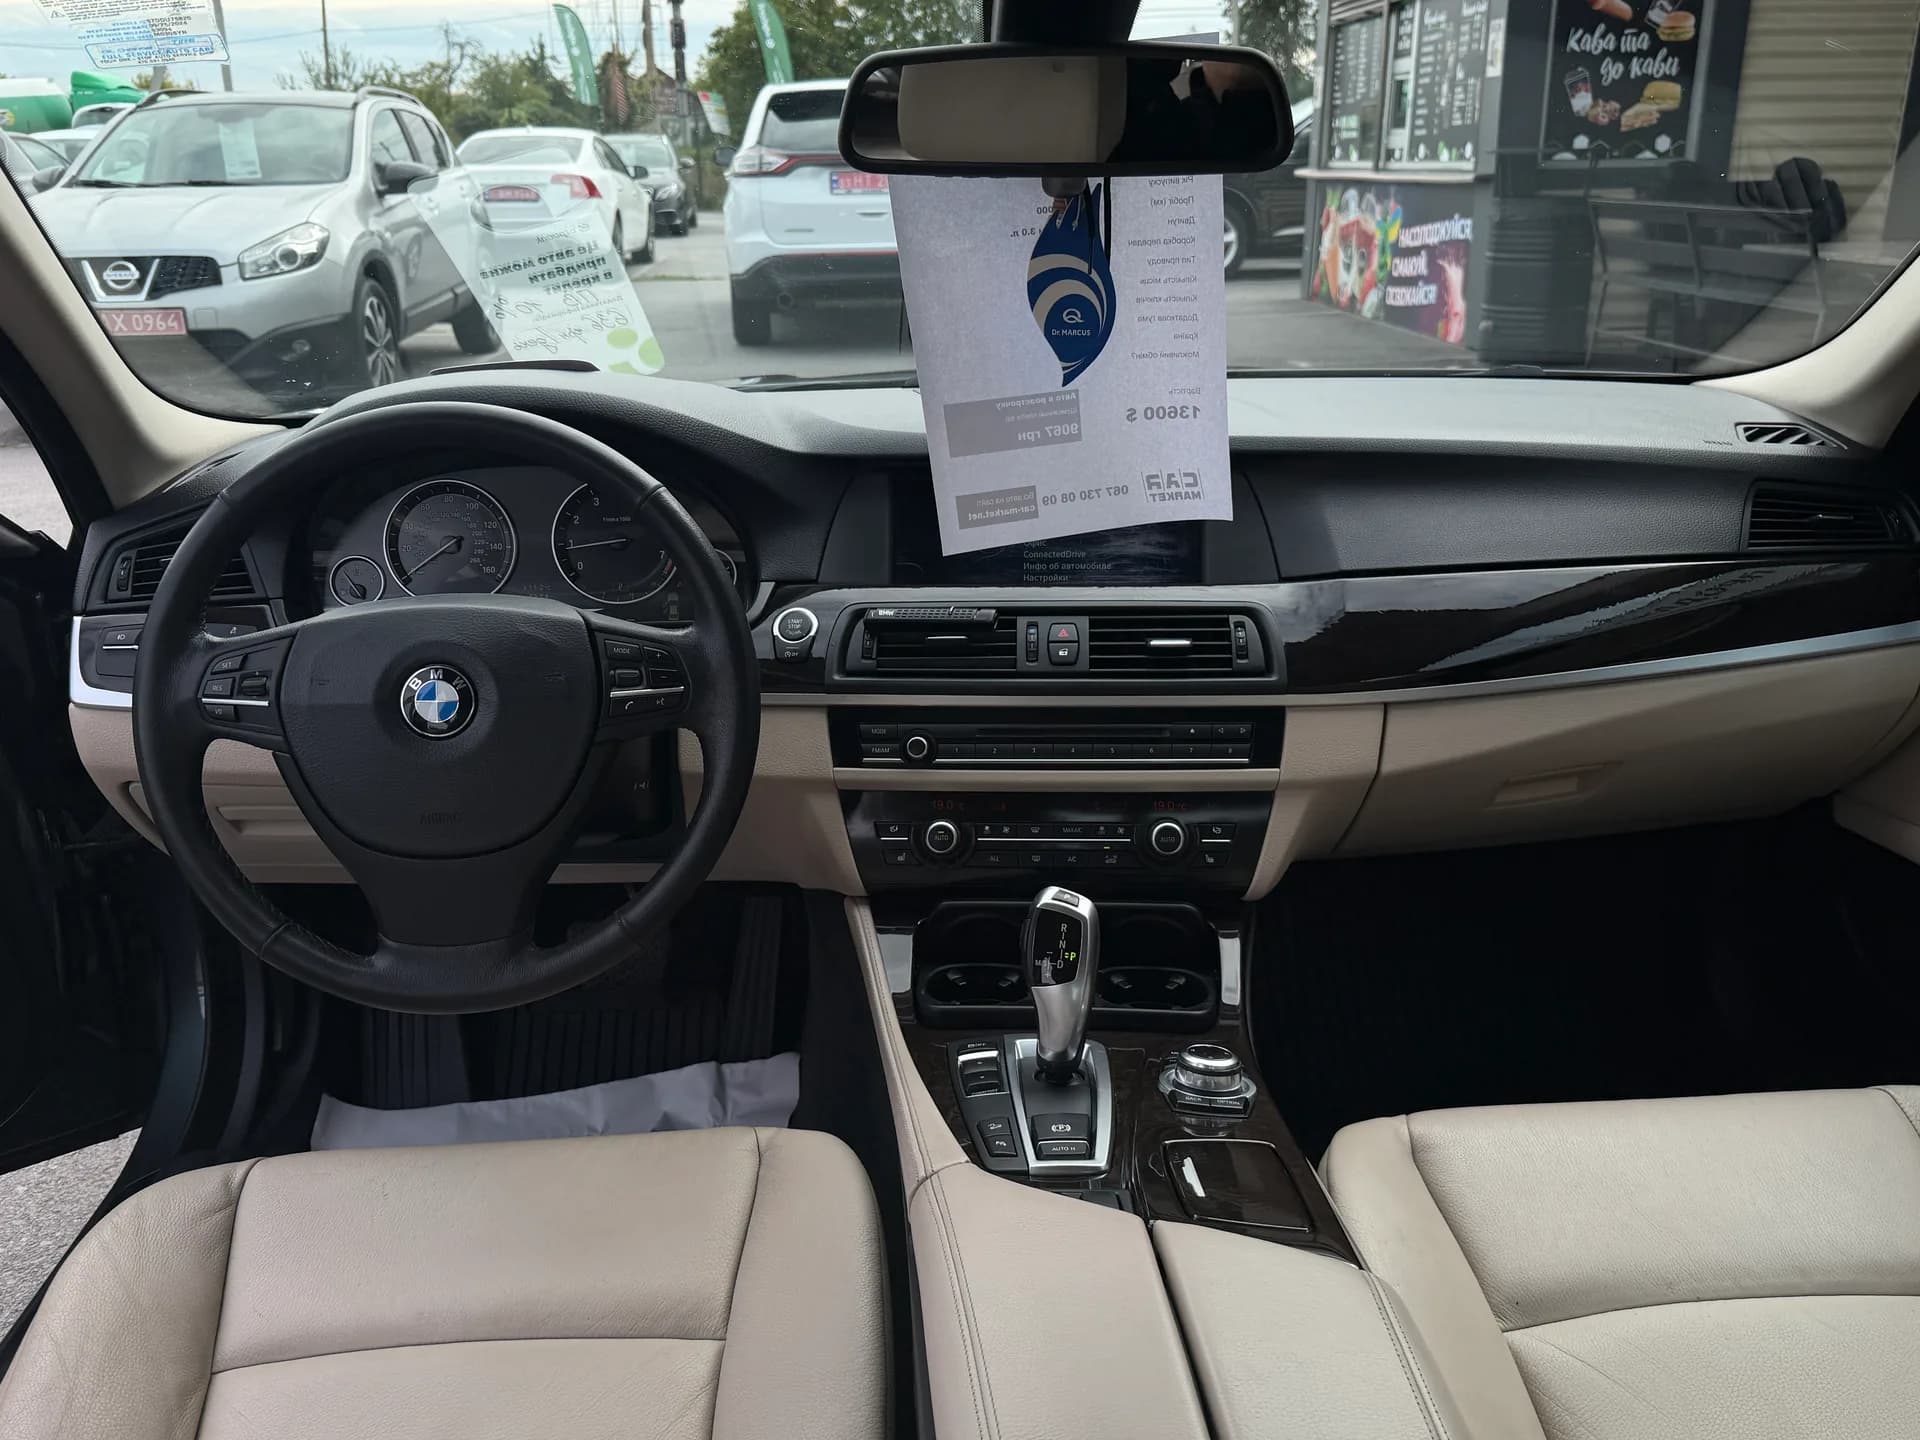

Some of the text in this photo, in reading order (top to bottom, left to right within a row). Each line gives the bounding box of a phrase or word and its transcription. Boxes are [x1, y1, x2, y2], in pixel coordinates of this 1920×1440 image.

[1567, 23, 1650, 55] Кава та
[1600, 48, 1680, 86] до кави
[132, 314, 178, 331] 0964
[1051, 328, 1091, 337] Dr. MARCUS
[593, 498, 600, 506] 3
[573, 516, 580, 524] 2
[659, 550, 665, 559] 7
[1023, 550, 1086, 559] ConnectedDrive
[577, 562, 583, 570] 0
[1023, 562, 1112, 572] Инфо об автомобиле
[1023, 573, 1069, 583] Настройки
[878, 609, 895, 617] BMW
[409, 669, 467, 691] BMW
[1061, 923, 1068, 932] R
[1059, 940, 1066, 949] N
[1070, 952, 1076, 961] P
[1057, 960, 1064, 969] D
